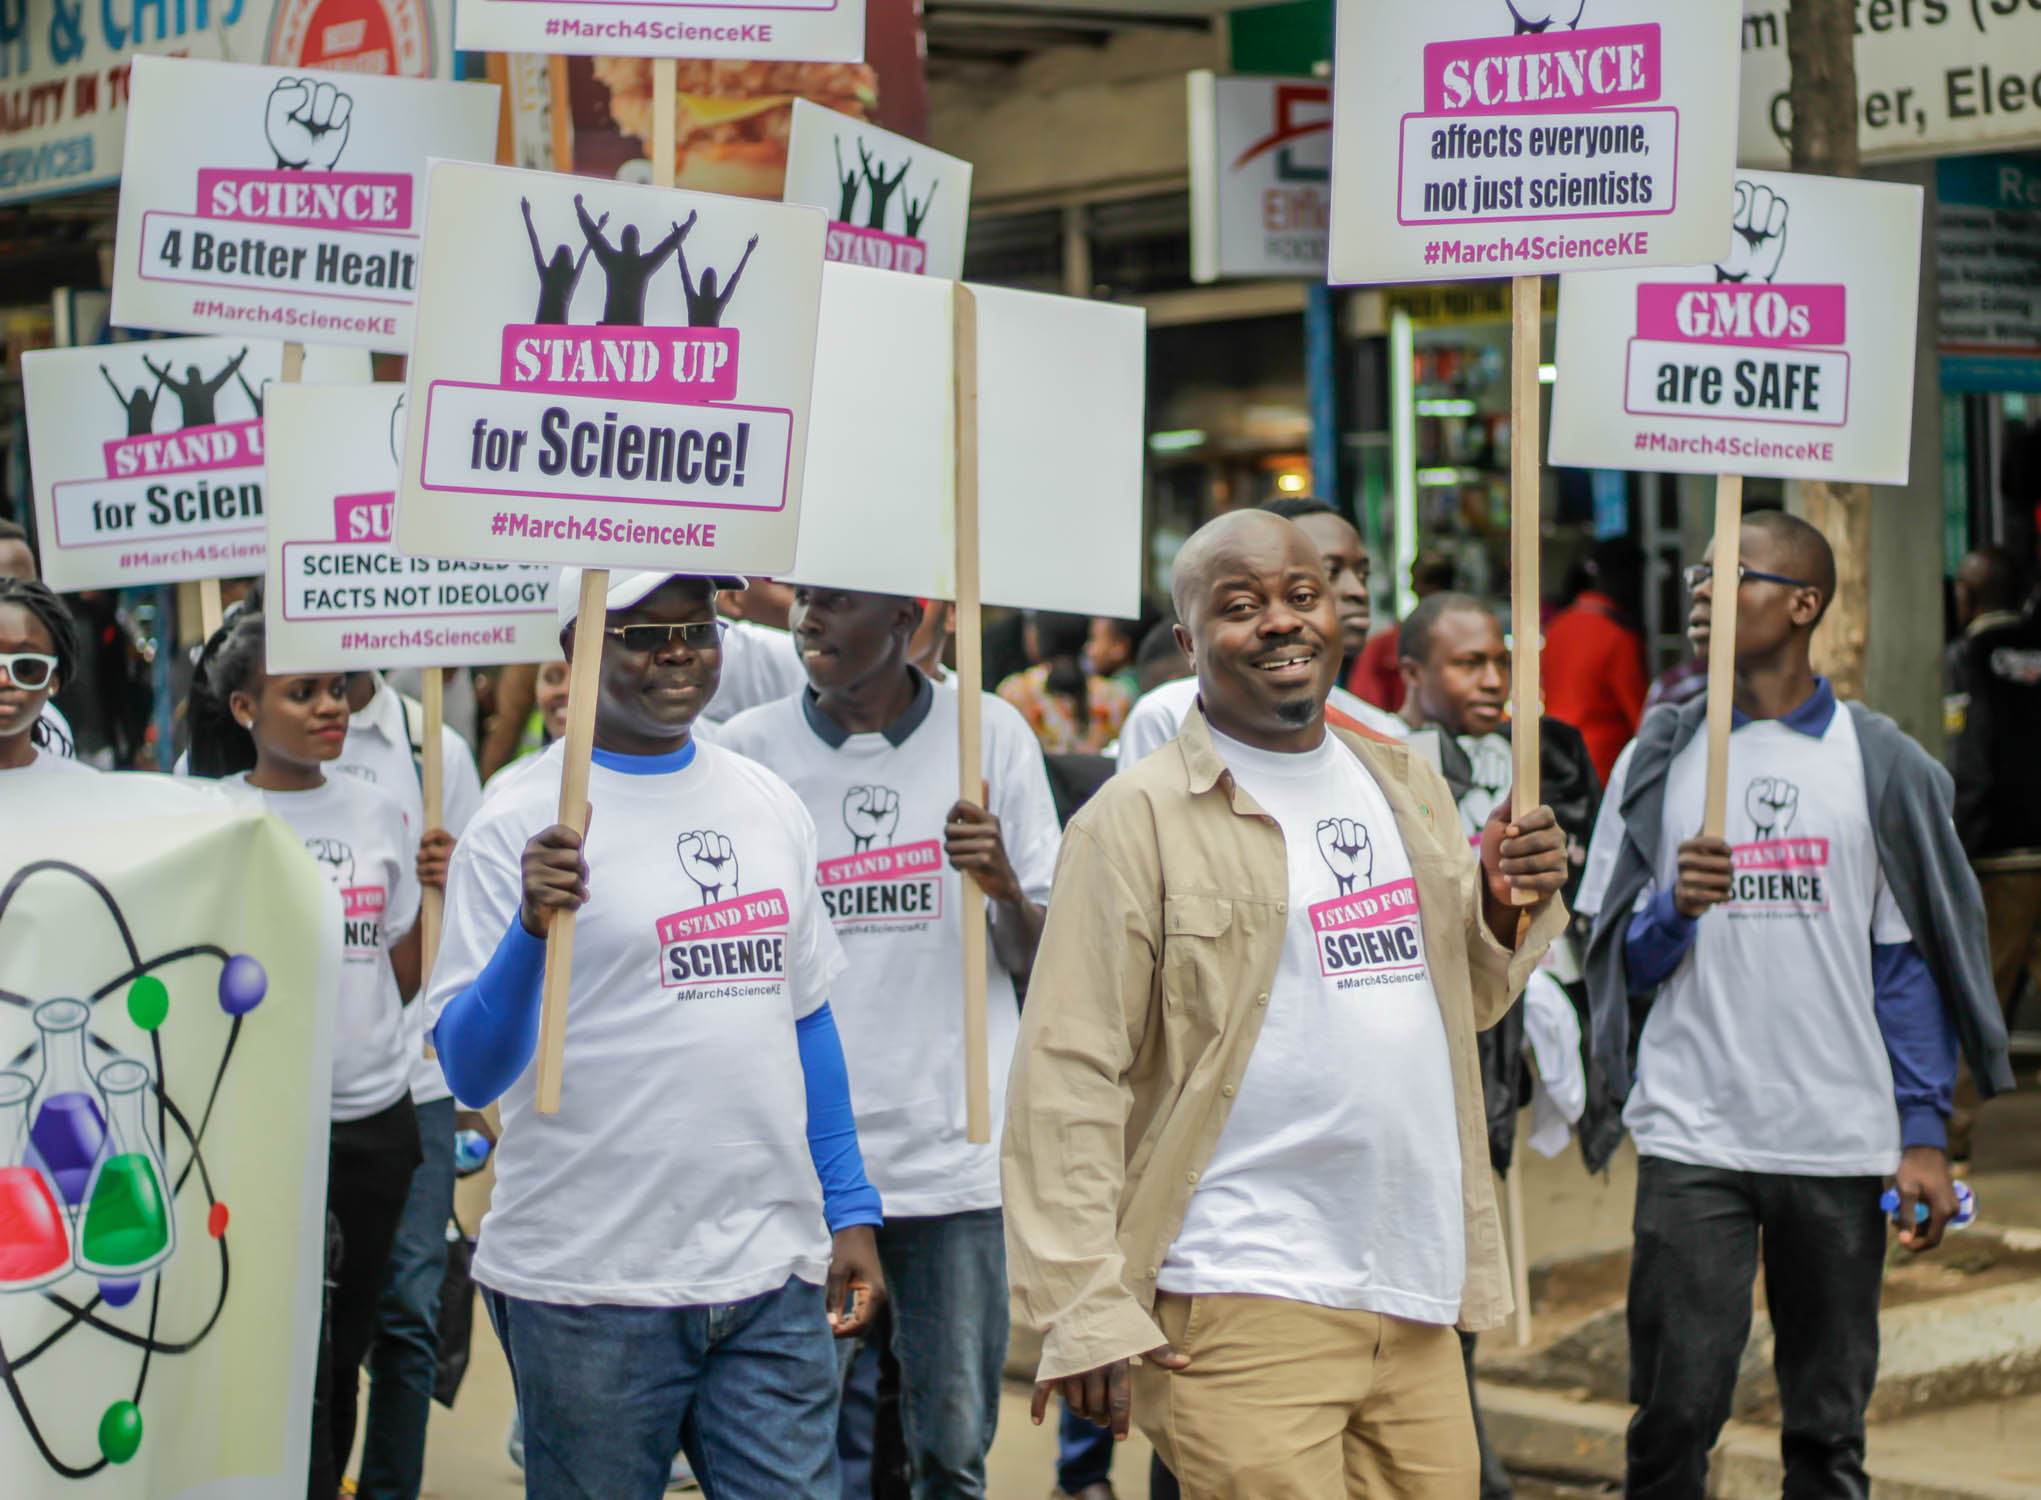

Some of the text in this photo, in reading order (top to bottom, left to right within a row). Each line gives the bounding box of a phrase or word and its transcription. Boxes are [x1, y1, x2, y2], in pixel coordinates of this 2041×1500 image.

[545, 19, 773, 42] #March4ScienceKE
[1442, 43, 1647, 109] SCIENCE
[1431, 122, 1650, 162] affects everyone,
[211, 180, 399, 221] SCIENCE
[1423, 172, 1654, 214] not just scientists
[160, 230, 182, 267] 4
[192, 232, 308, 282] Better
[1423, 232, 1649, 265] #March4ScienceKE
[193, 300, 397, 335] #March4ScienceKE
[1675, 291, 1811, 338] GMOs
[514, 338, 729, 384] STAND UP
[1657, 359, 1820, 412] are SAFE
[114, 431, 237, 478] STAND
[470, 406, 751, 487] for Science!
[1634, 433, 1834, 462] #March4ScienceKE
[92, 500, 136, 531] for
[491, 512, 718, 547] #March4ScienceKE
[303, 554, 403, 575] SCIENCE
[410, 557, 430, 573] IS
[304, 583, 549, 611] FACTS NOT IDEOLOGY
[341, 626, 516, 650] #March4ScienceKE
[828, 855, 892, 882] STAND
[895, 847, 936, 868] FOR
[663, 897, 784, 942] I STAND FOR
[821, 883, 932, 918] SCIENCE
[1326, 899, 1378, 928] STAND
[1379, 887, 1416, 912] FOR
[669, 938, 783, 979] SCIENCE
[677, 983, 782, 1001] #March4ScienceKE
